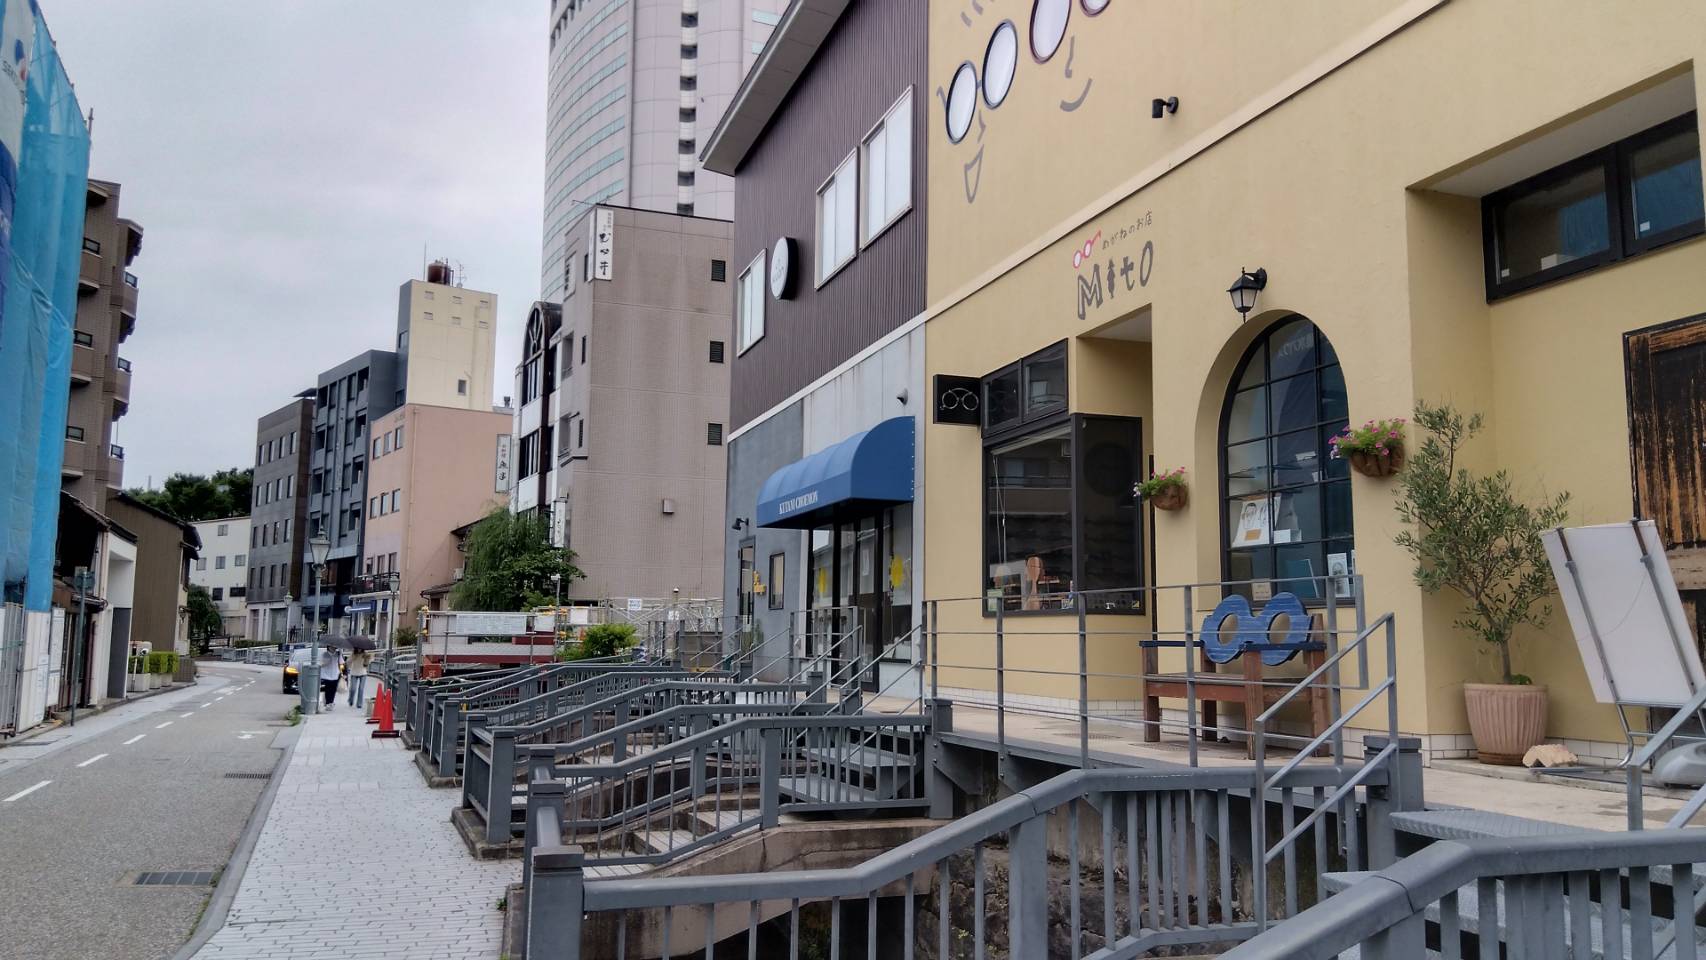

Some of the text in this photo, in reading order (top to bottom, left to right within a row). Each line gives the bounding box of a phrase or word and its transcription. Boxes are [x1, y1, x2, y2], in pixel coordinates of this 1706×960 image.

[1102, 209, 1153, 250] めがねのお店
